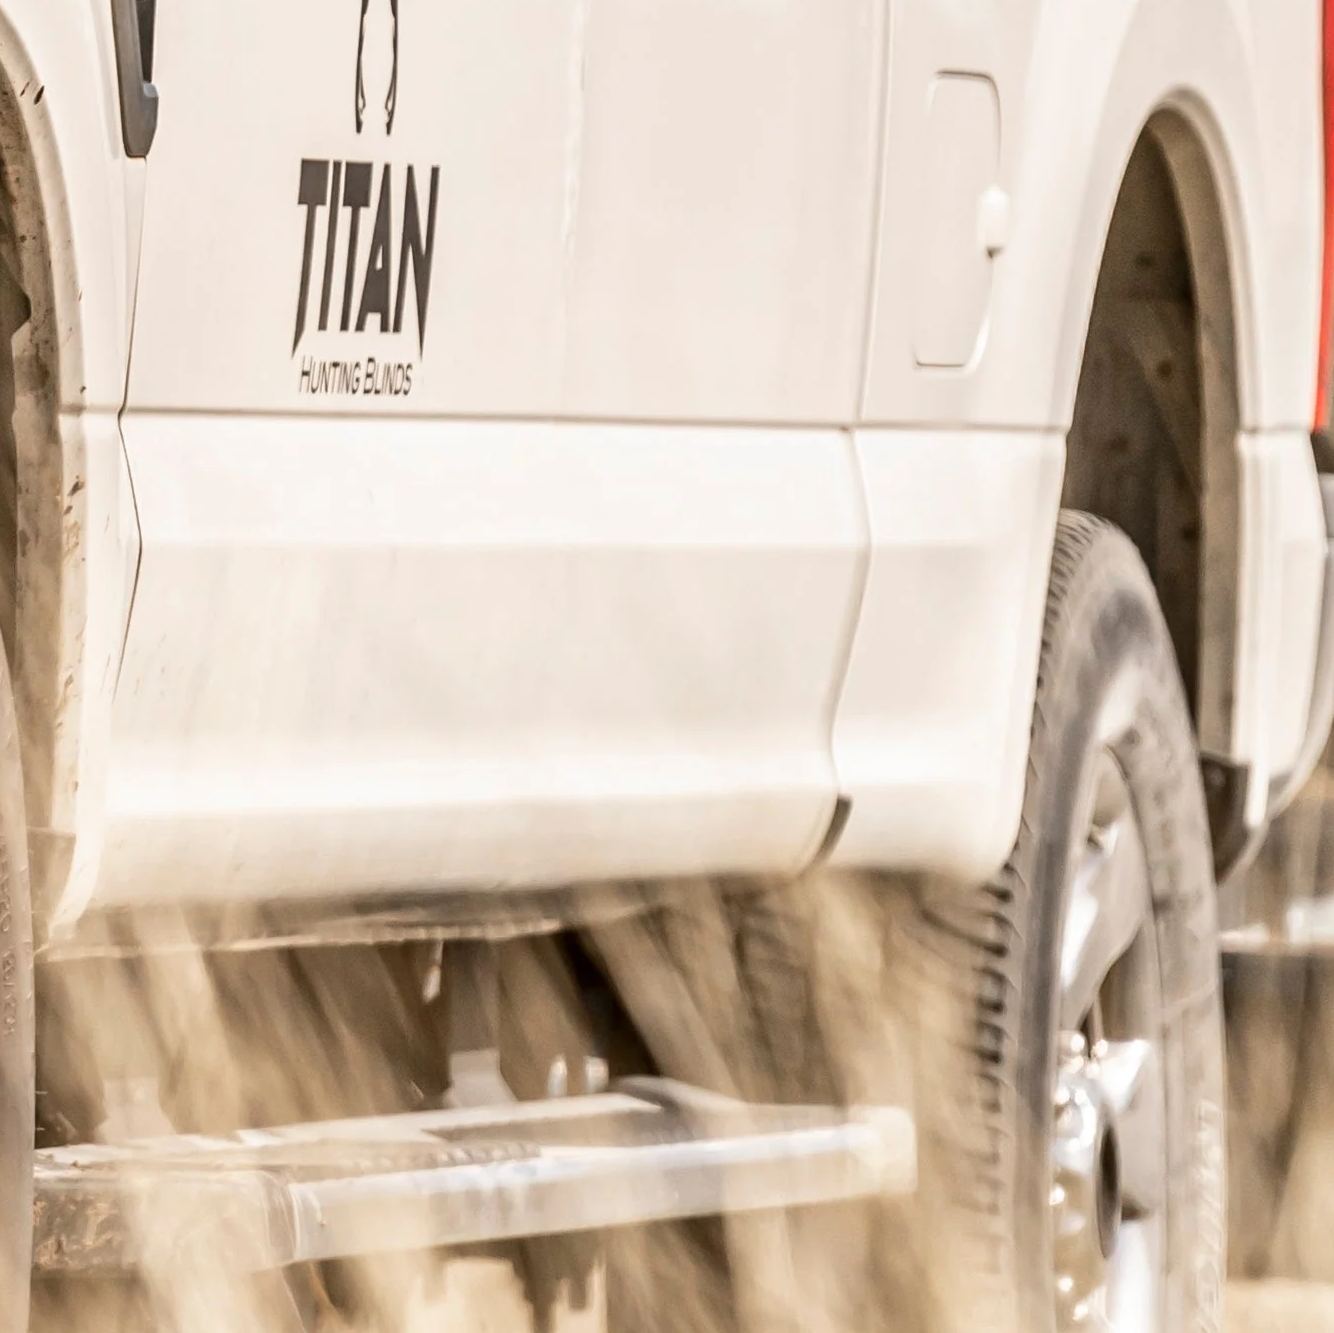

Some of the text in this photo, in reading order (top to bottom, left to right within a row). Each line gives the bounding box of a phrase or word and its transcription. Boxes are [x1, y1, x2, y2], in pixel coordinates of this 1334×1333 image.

[291, 158, 440, 363] TITAN
[299, 355, 413, 396] HUNTING BLINDS
